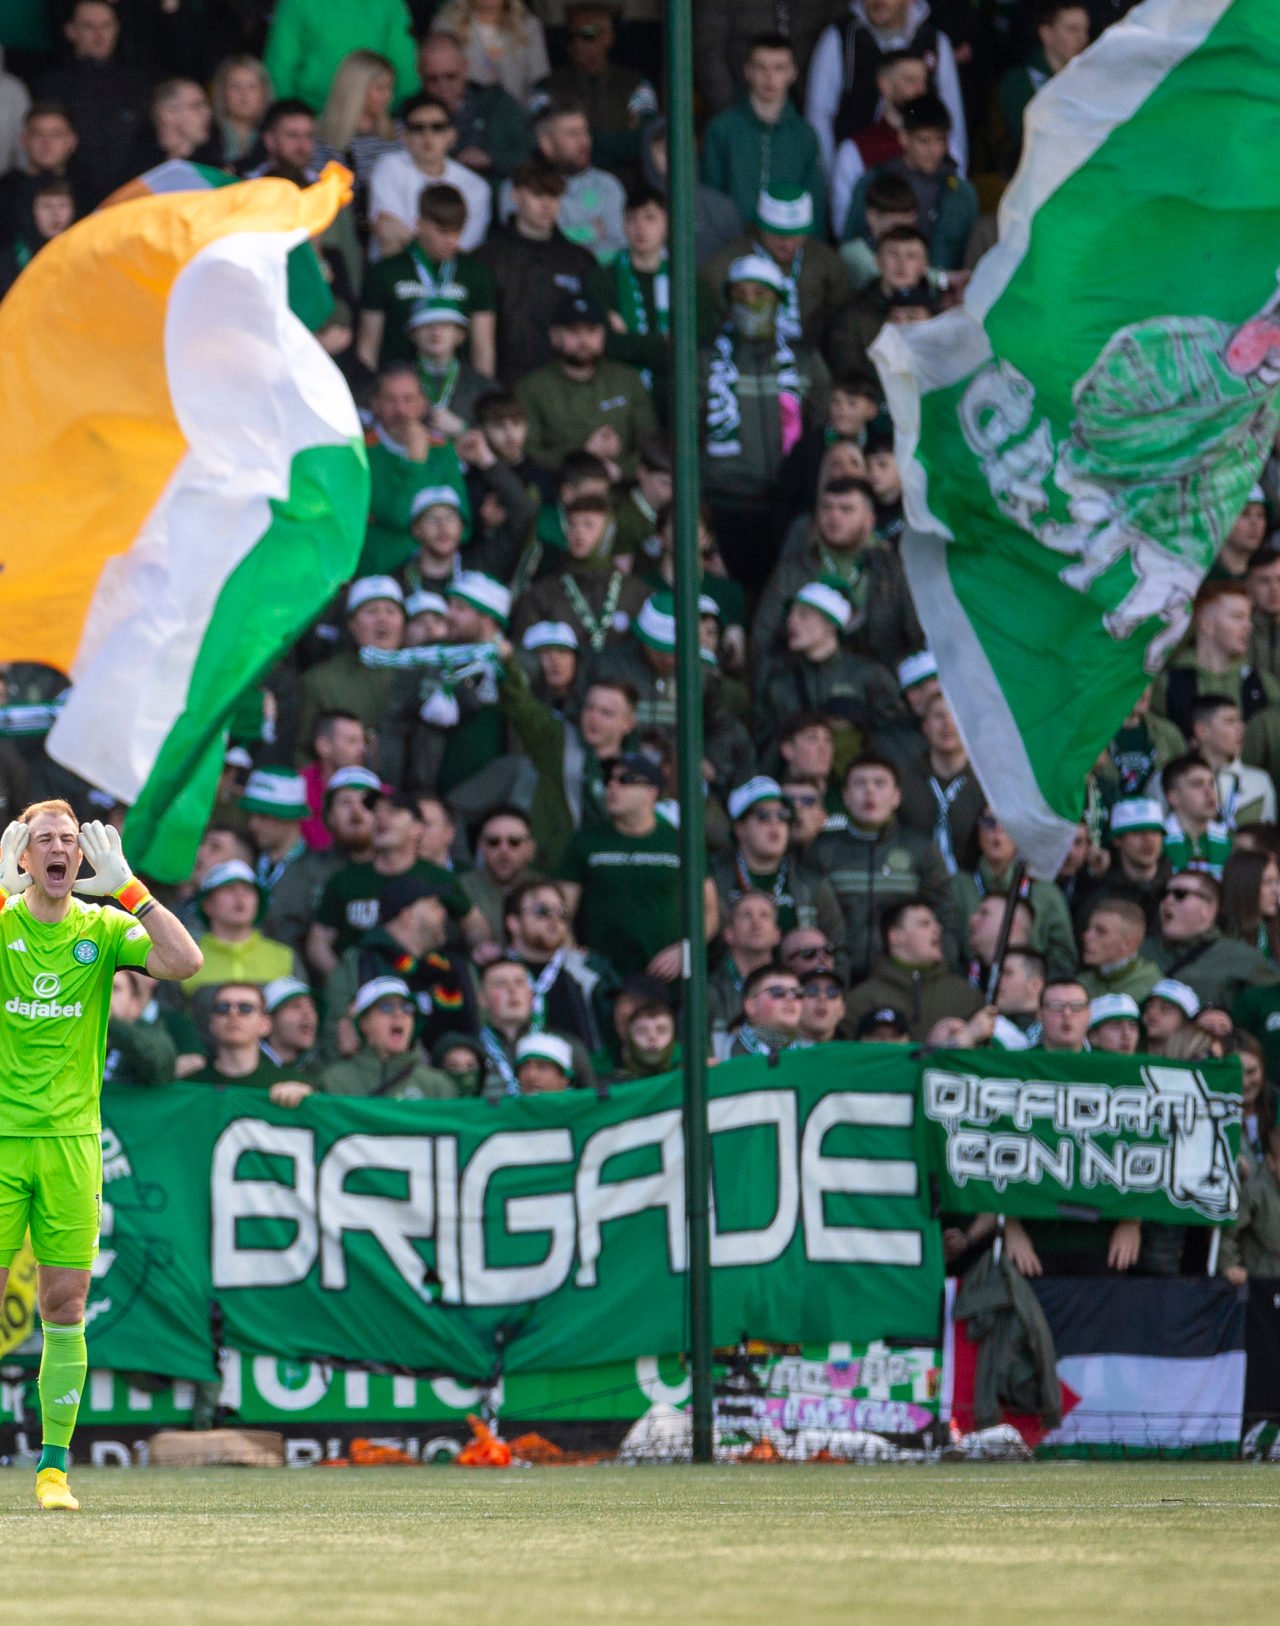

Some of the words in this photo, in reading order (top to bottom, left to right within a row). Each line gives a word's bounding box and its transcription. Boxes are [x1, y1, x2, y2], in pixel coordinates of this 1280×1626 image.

[5, 996, 82, 1019] dafabet
[924, 1069, 1197, 1137] DIFFIDATI
[948, 1130, 1073, 1191] CON
[211, 1089, 922, 1306] BRIGADE
